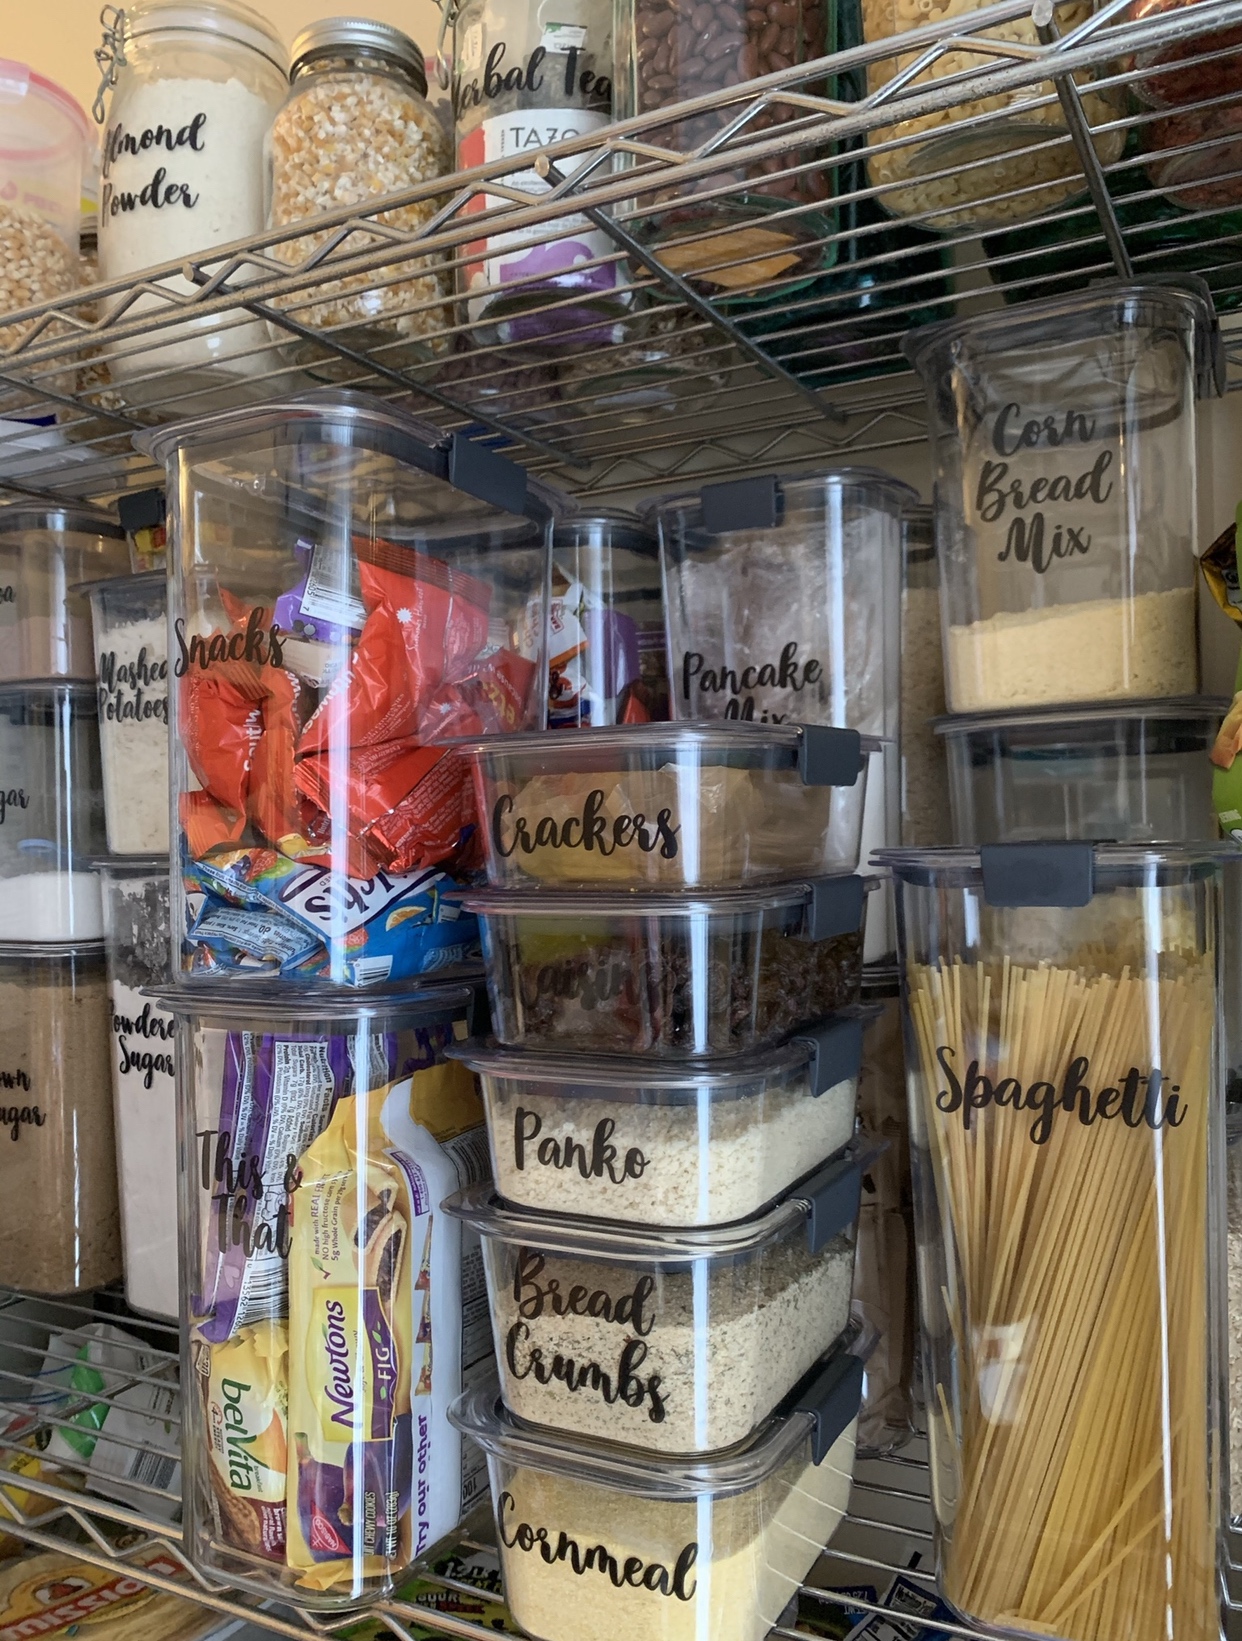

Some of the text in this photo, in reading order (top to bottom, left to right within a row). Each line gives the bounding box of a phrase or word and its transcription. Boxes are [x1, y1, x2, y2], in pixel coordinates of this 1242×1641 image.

[560, 46, 611, 102] Tea
[991, 402, 1096, 456] Corn
[976, 450, 1113, 522] Bread
[998, 512, 1092, 574] Mix
[174, 607, 287, 678] Snacks
[682, 642, 823, 699] Pancake
[492, 789, 681, 860] Crackers
[112, 1001, 175, 1041] owdere
[119, 1034, 175, 1089] Sugar
[319, 1046, 332, 1083] Nutrition
[275, 1067, 283, 1094] Potassium
[282, 1075, 290, 1096] Vitamin
[935, 1046, 1188, 1145] Spaghetti
[321, 1088, 332, 1112] Facts
[0, 1106, 46, 1141] ugar
[236, 1133, 244, 1146] Daily
[276, 1126, 284, 1148] Calcium
[285, 1114, 294, 1132] Added
[234, 1147, 242, 1160] Value
[267, 1146, 275, 1159] Daily
[514, 1106, 650, 1184] Panko
[196, 1129, 302, 1200] This &
[311, 1195, 320, 1217] REAL
[326, 1186, 334, 1197] corn
[212, 1193, 292, 1260] That
[322, 1199, 330, 1228] fructose
[322, 1230, 330, 1245] high
[322, 1247, 329, 1260] NO
[331, 1250, 340, 1261] 5g
[514, 1246, 655, 1337] Bread
[325, 1300, 363, 1429] Newtons
[375, 1348, 392, 1380] FIG
[506, 1321, 670, 1423] Crumbs
[222, 1378, 270, 1490] belVita
[254, 1465, 264, 1493] breakfast
[415, 1413, 430, 1558] Try our other
[364, 1492, 375, 1518] COOKIES
[315, 1517, 338, 1549] NABISCO
[364, 1519, 375, 1544] CHEWY
[386, 1536, 397, 1551] WT
[500, 1491, 699, 1601] Cornmeal
